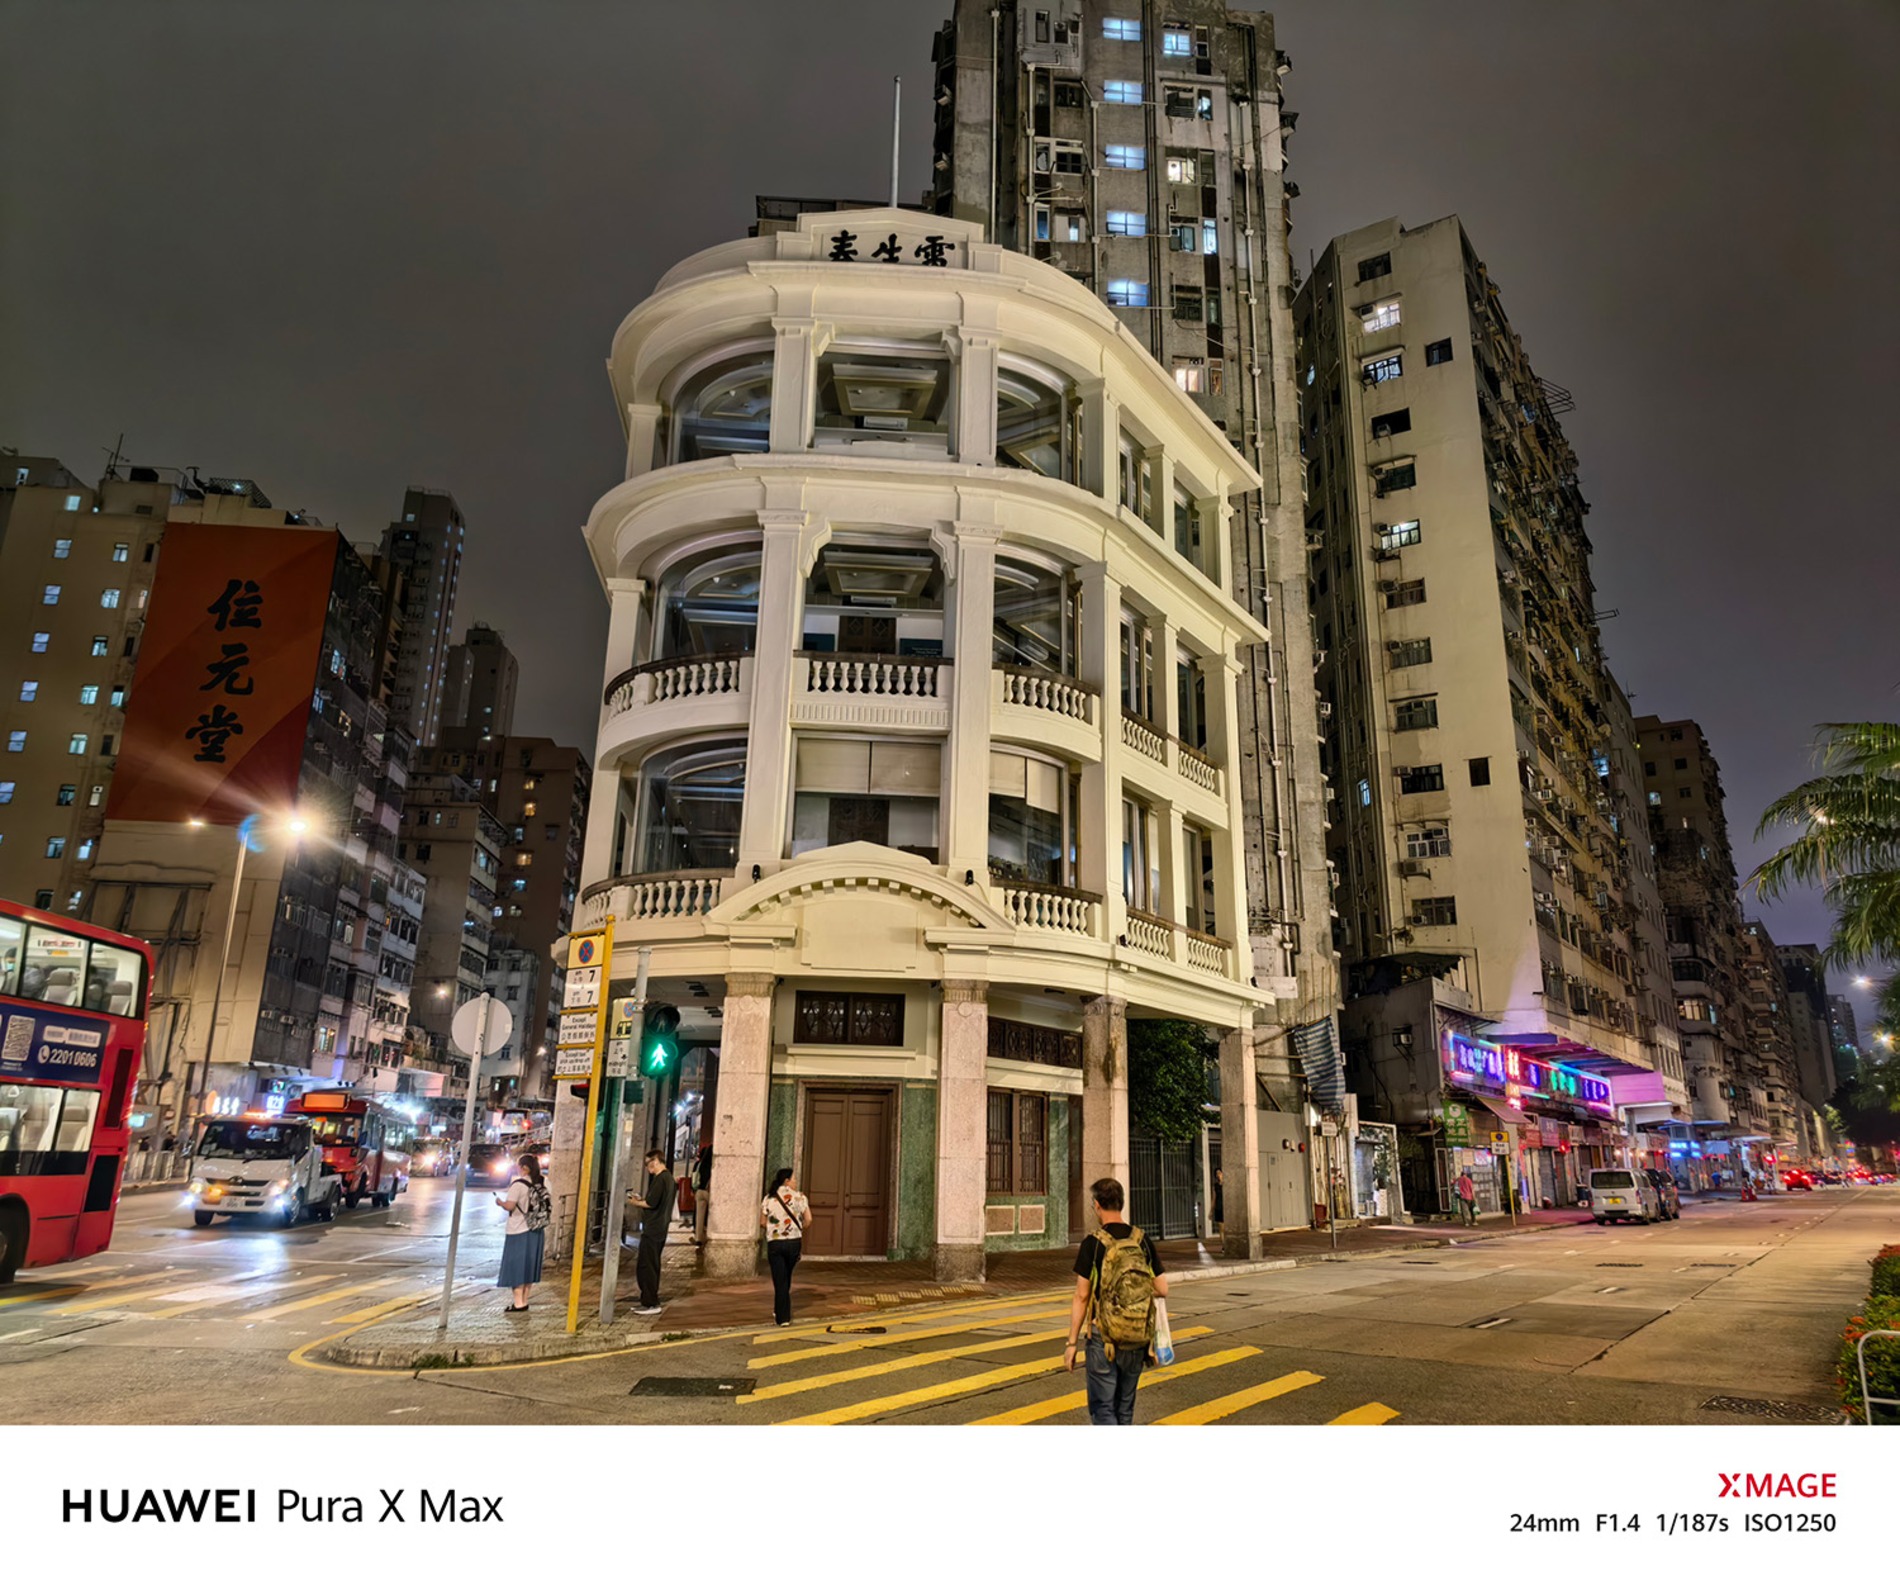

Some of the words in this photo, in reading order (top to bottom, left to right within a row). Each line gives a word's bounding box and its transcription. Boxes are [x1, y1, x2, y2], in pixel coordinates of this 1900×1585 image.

[185, 579, 263, 763] 位元堂
[589, 970, 595, 982] 7
[587, 991, 593, 1003] 7
